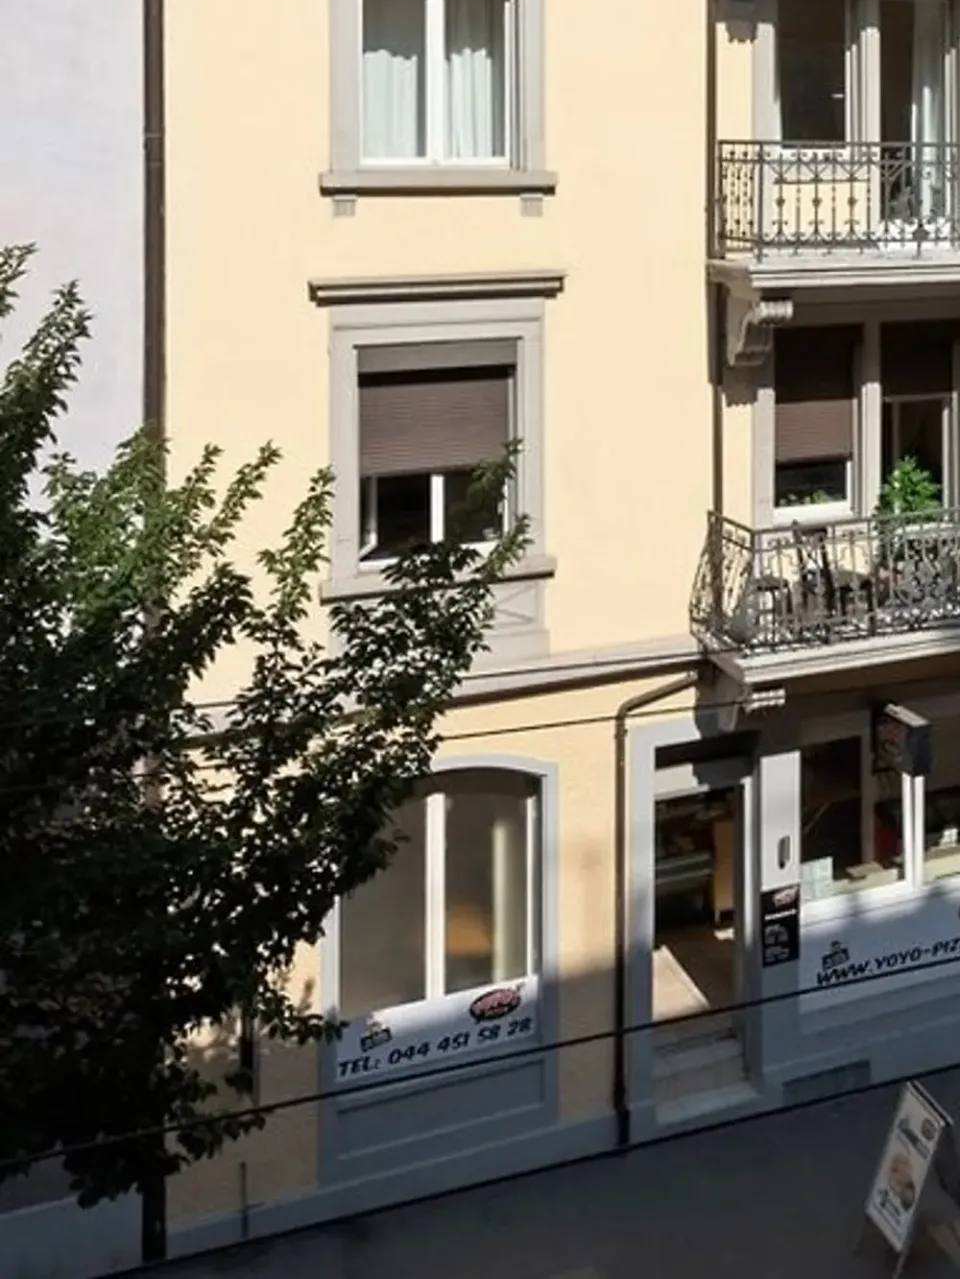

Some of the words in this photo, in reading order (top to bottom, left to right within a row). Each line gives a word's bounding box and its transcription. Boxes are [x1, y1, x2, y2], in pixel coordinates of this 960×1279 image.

[388, 1042, 430, 1065] 044
[436, 1032, 470, 1052] 451
[478, 1026, 501, 1041] 58
[507, 1018, 531, 1036] 28
